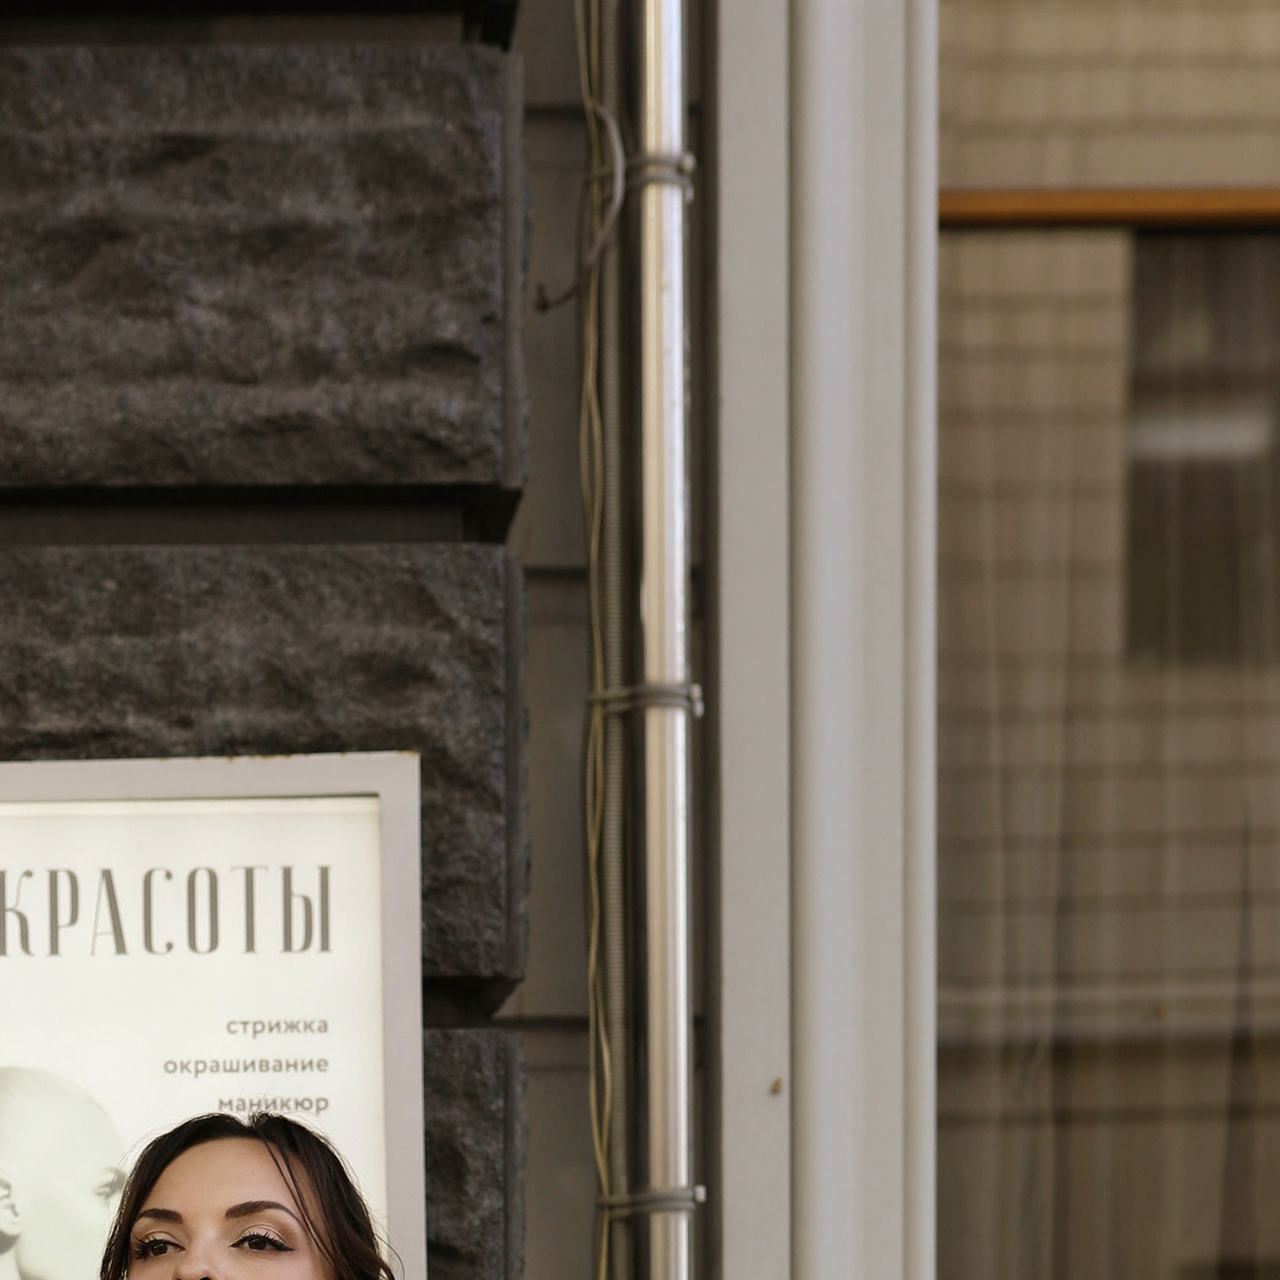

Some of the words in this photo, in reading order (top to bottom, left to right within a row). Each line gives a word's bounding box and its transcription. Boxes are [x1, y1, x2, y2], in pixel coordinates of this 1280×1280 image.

[227, 1020, 328, 1038] стрижка
[164, 1059, 328, 1078] окрашивание
[219, 1098, 328, 1115] маникюр
